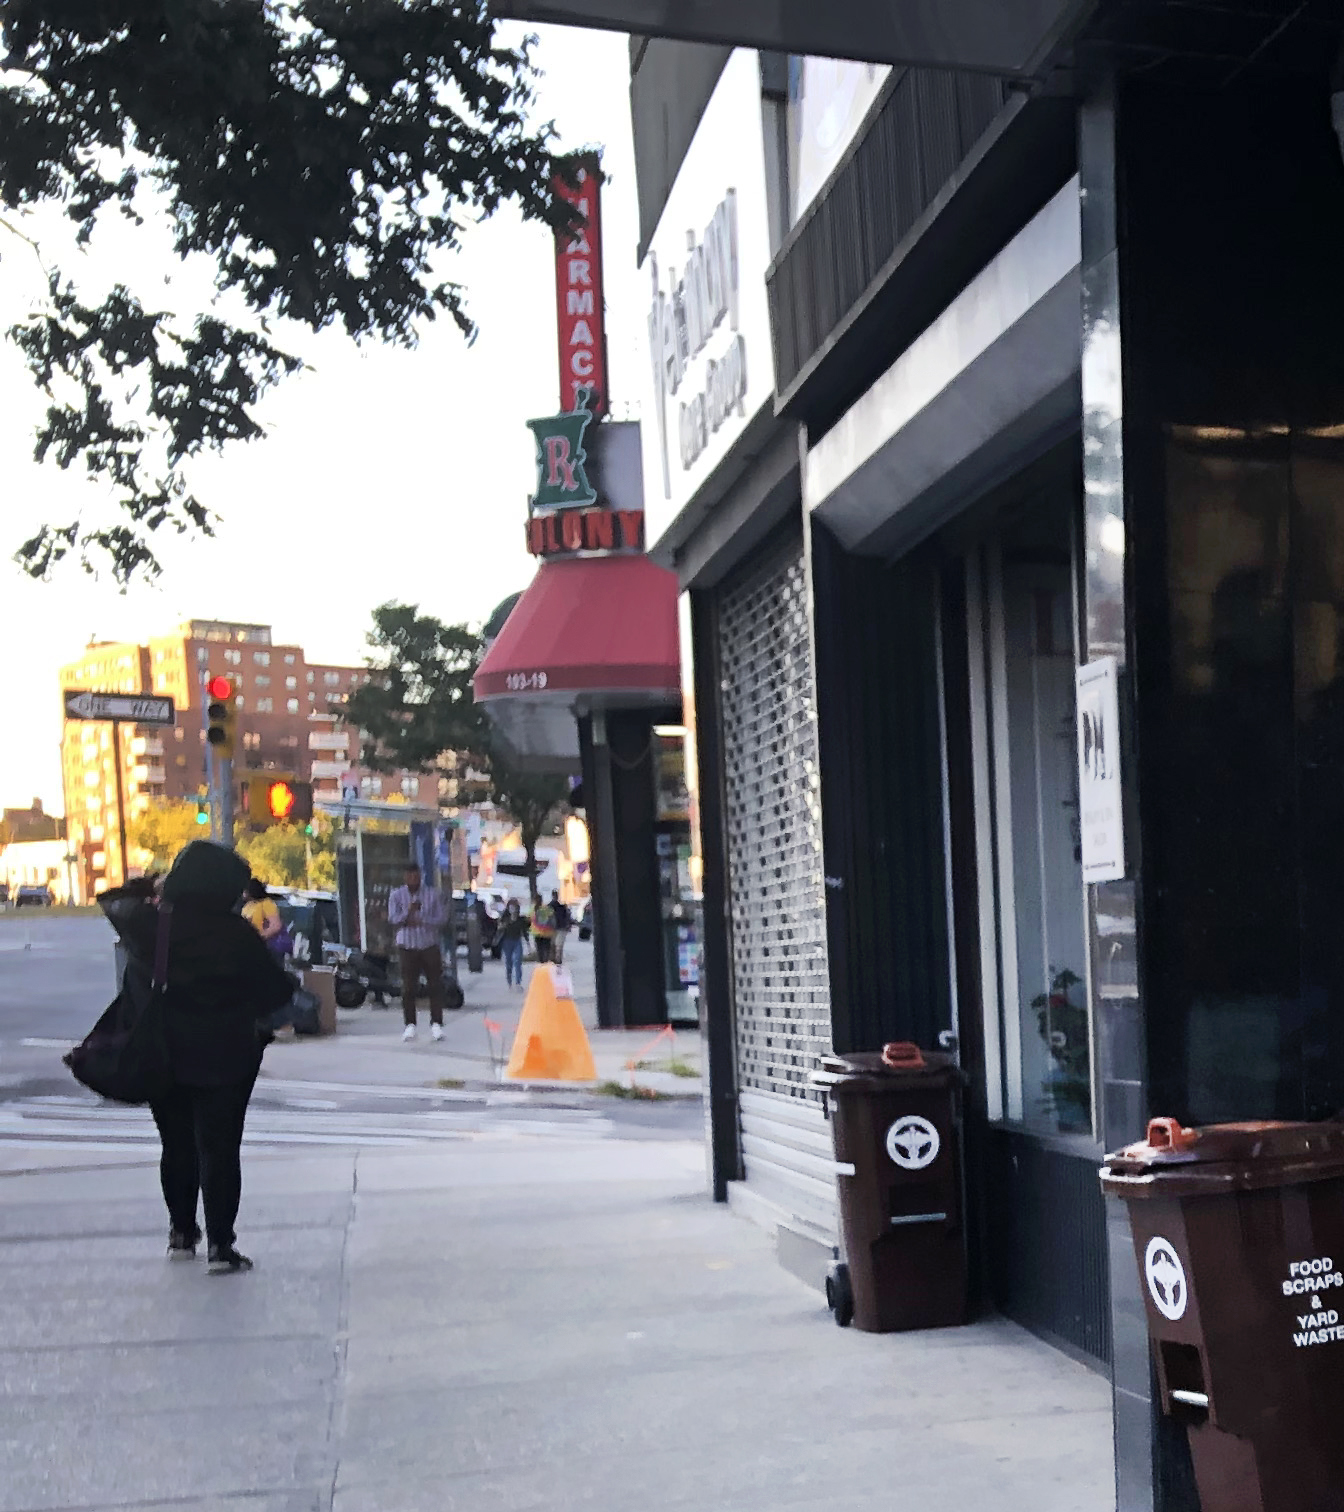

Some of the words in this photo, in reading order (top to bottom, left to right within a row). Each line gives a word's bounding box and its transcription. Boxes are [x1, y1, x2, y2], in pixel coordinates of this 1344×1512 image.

[1289, 1256, 1333, 1278] FOOD
[1282, 1271, 1344, 1296] SCRAPS
[1310, 1294, 1323, 1310] &
[1296, 1309, 1339, 1330] YARD
